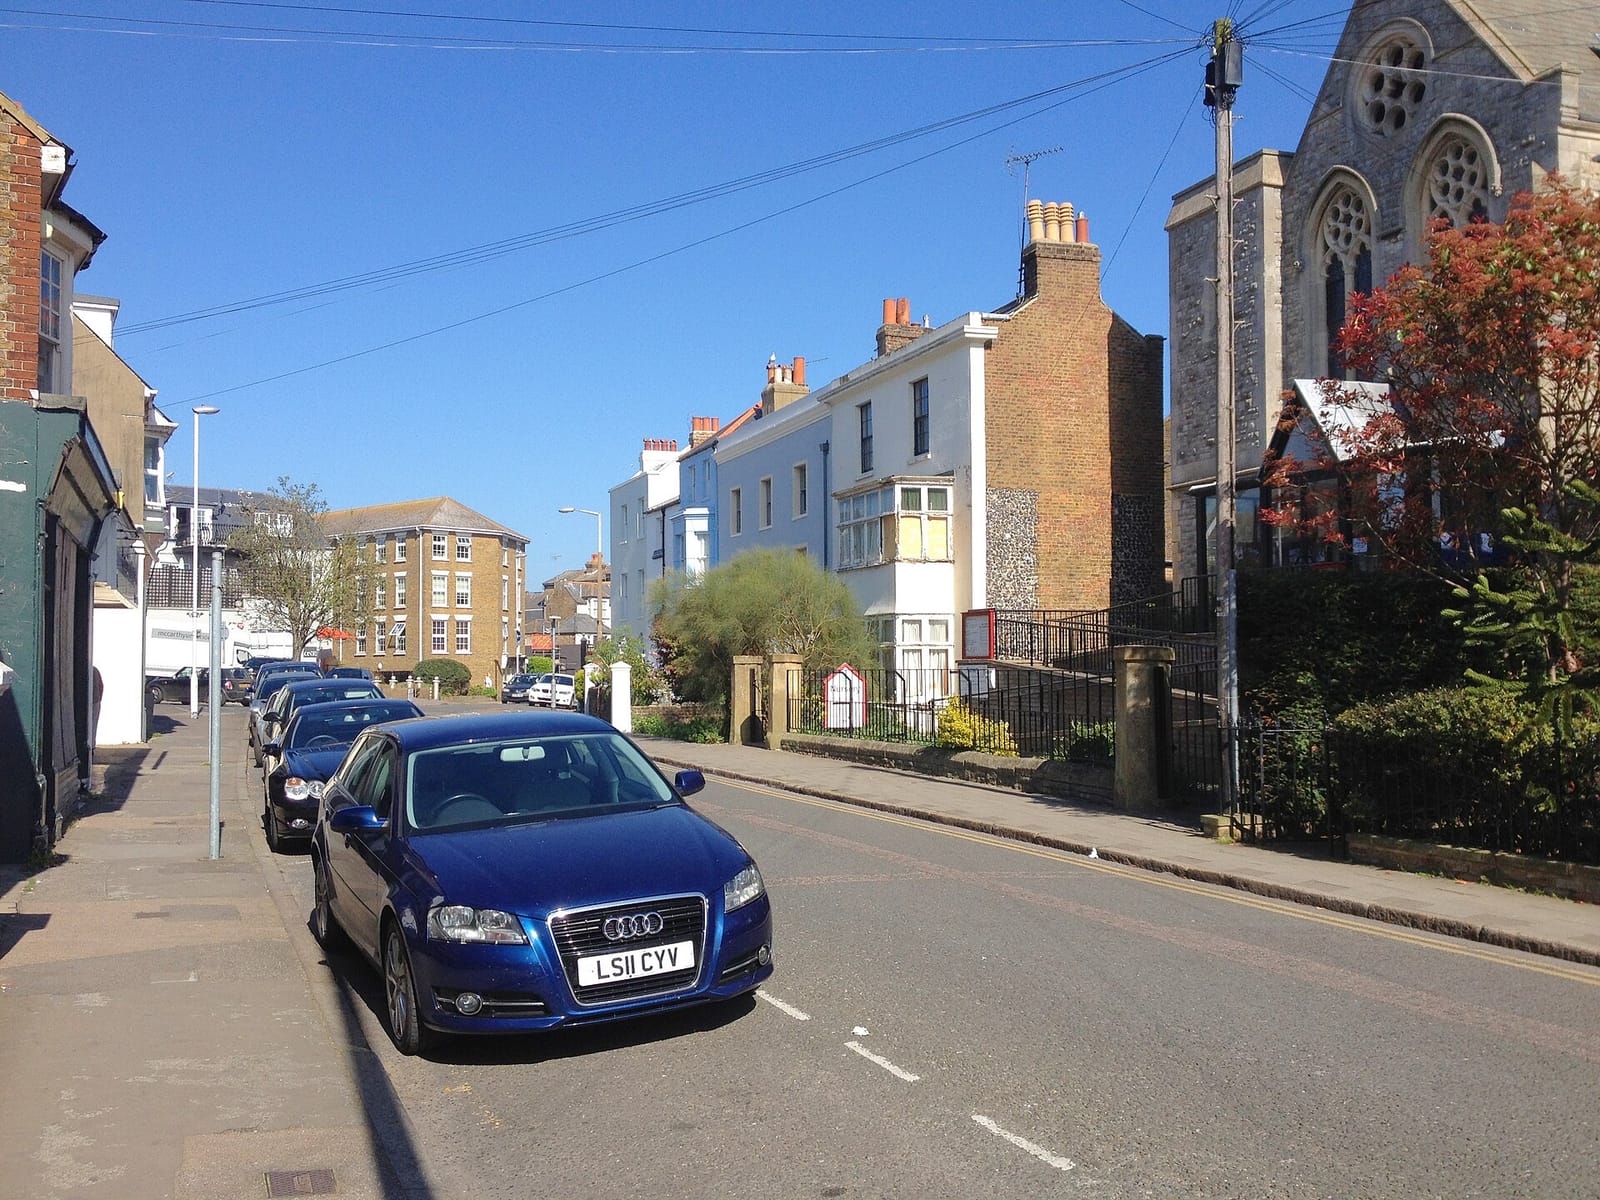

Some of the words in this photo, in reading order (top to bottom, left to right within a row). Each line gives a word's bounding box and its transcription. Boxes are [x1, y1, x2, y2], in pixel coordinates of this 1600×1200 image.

[831, 685, 861, 695] Nursry
[597, 955, 636, 979] LS11
[641, 947, 678, 972] CYV
